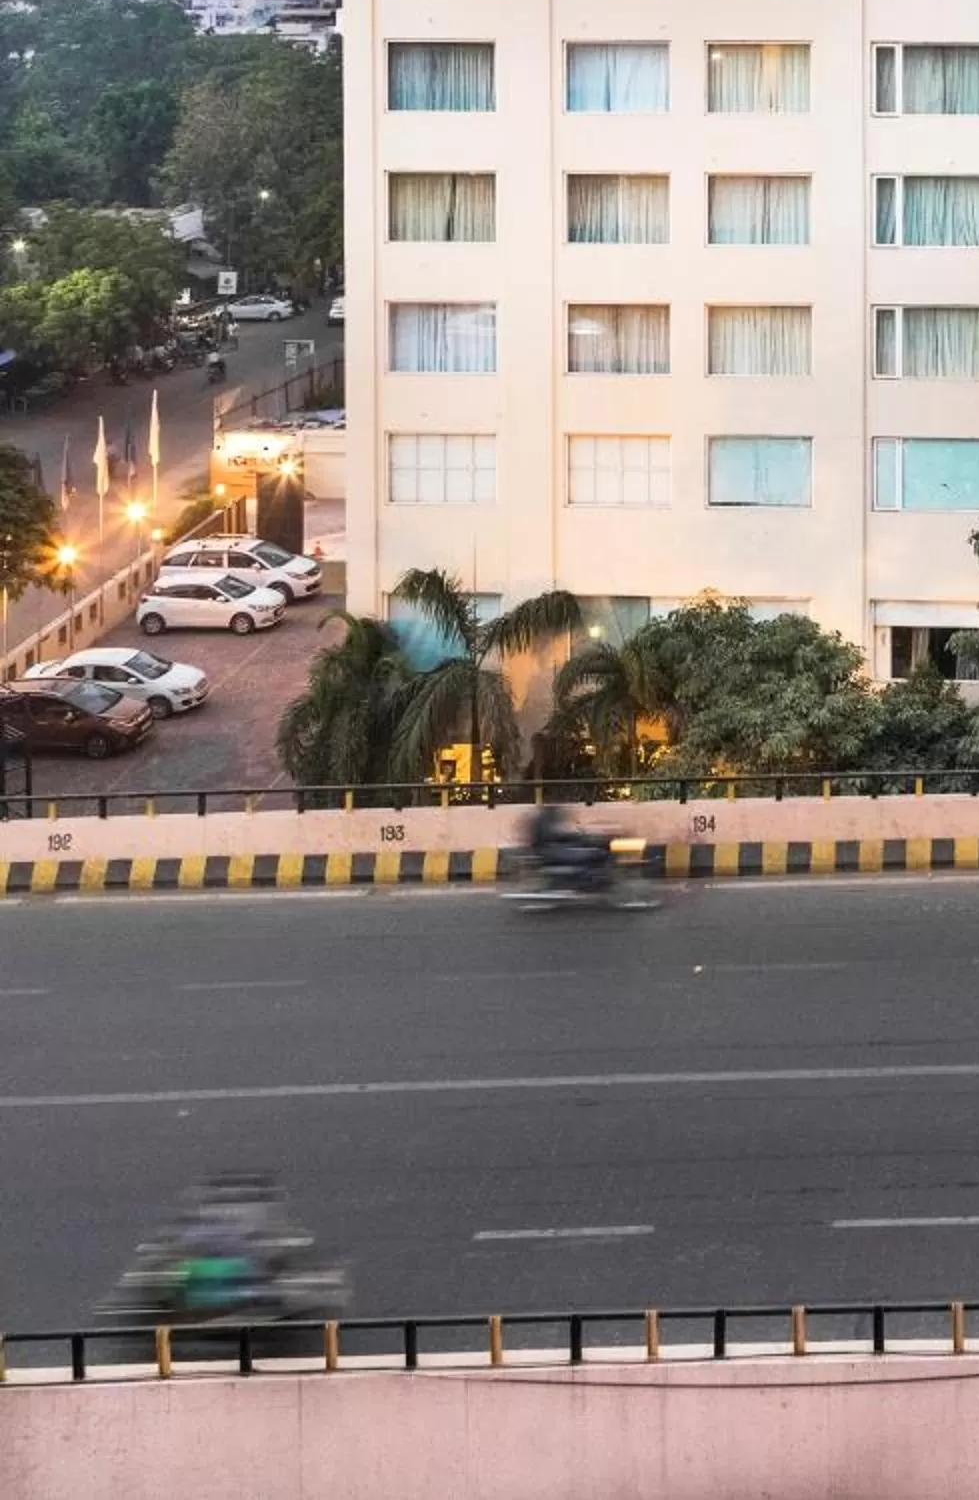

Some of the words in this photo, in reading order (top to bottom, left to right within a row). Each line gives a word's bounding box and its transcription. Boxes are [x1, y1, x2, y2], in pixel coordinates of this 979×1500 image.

[693, 815, 716, 832] 194
[380, 824, 405, 841] 193
[47, 833, 73, 851] 192
